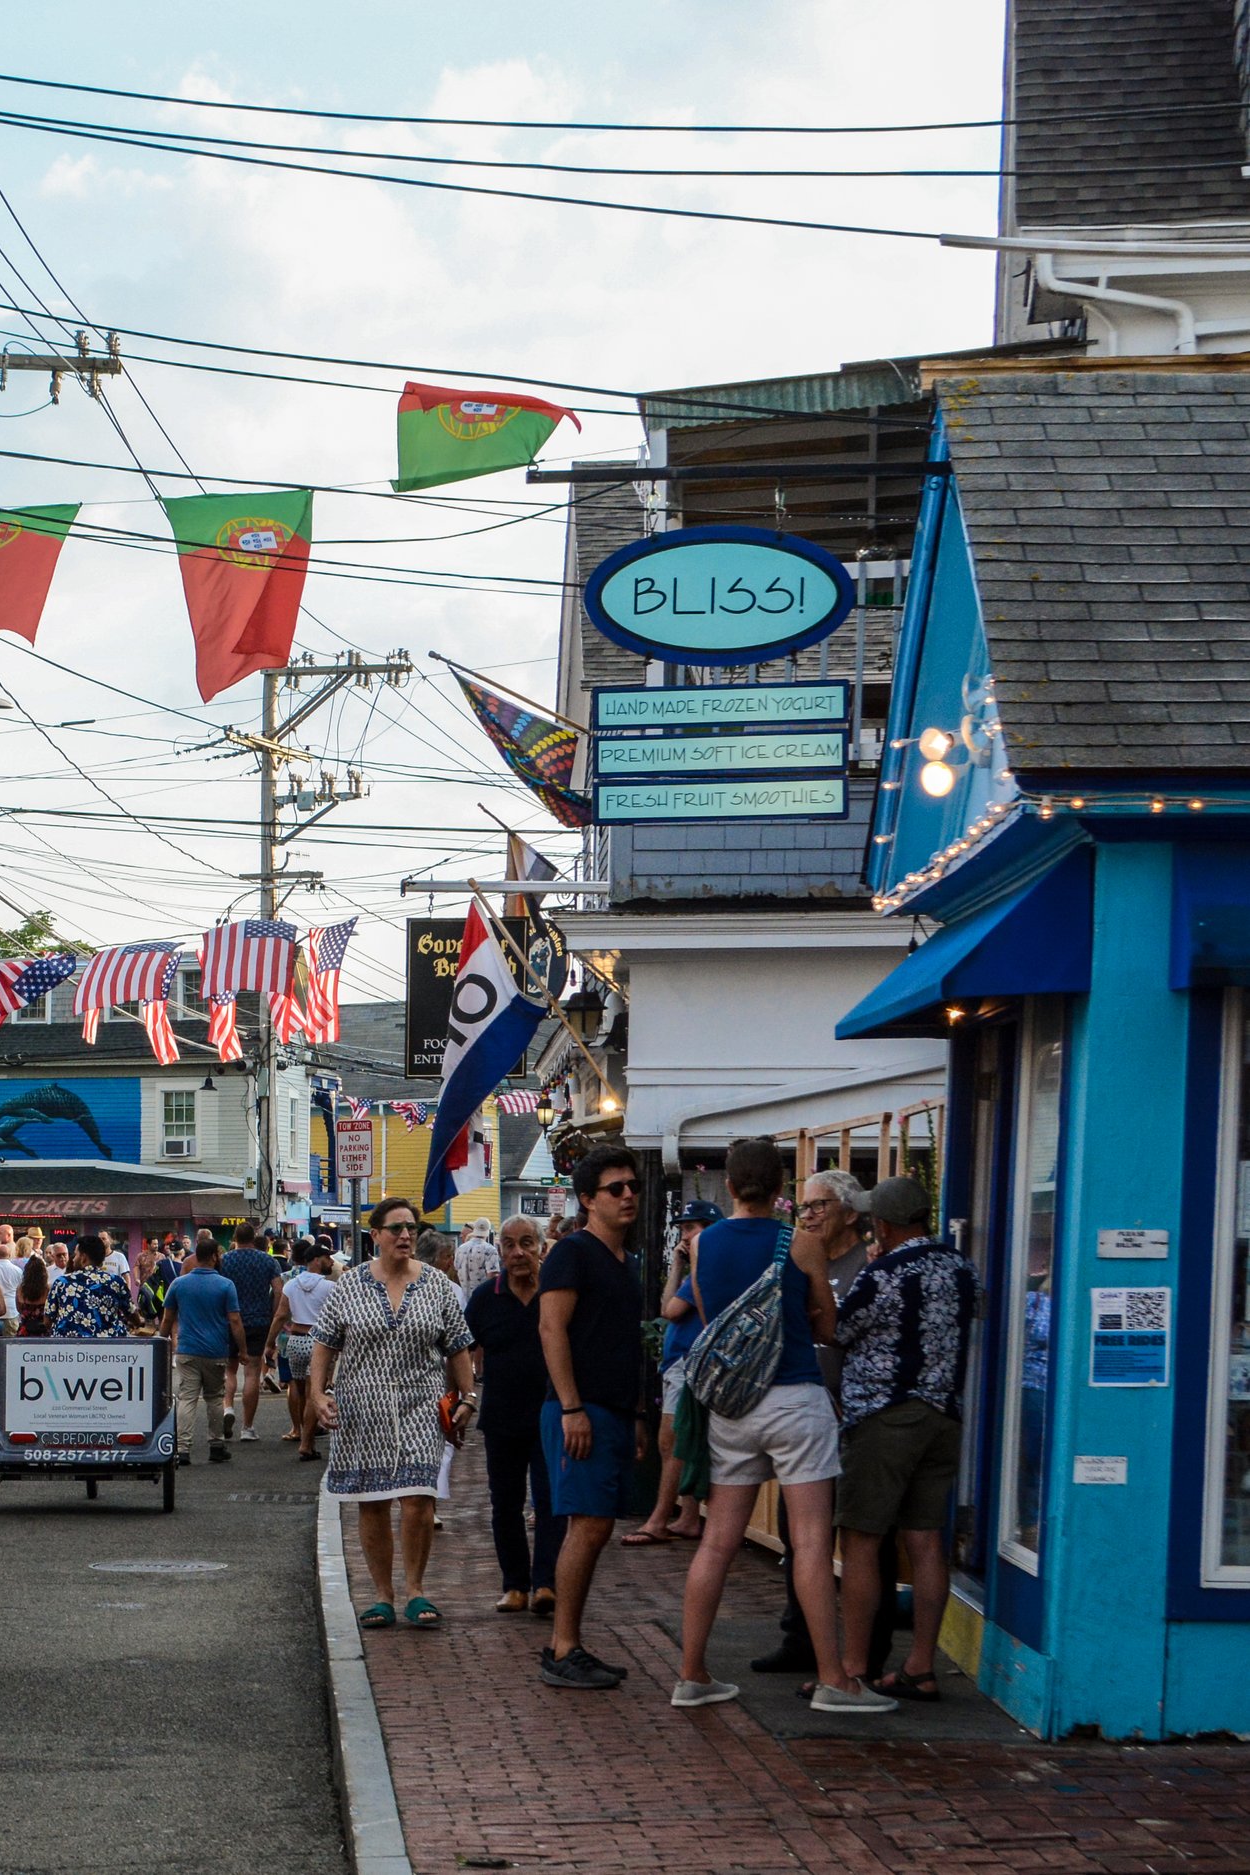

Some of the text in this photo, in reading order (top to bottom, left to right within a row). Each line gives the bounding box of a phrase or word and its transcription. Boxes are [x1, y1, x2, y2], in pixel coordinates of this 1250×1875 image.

[634, 576, 805, 615] BLISS!
[702, 695, 768, 714] FROZEN
[774, 695, 836, 714] YOGURT
[601, 743, 840, 764] PREMIUM SOFT ICE CREAM
[606, 788, 836, 810] FRESH FRUIT SMOOTHIES
[338, 1121, 371, 1131] TOW ZONE
[348, 1134, 361, 1142] NO
[339, 1143, 370, 1152] PARKING
[341, 1153, 368, 1162] EITHER
[345, 1163, 364, 1172] SIDE
[10, 1199, 109, 1214] TICKETS
[221, 1217, 247, 1226] ATM
[1094, 1334, 1166, 1346] FREE RIDES
[22, 1351, 139, 1365] Cannabis Dispensary
[23, 1449, 129, 1461] 508-257-1277
